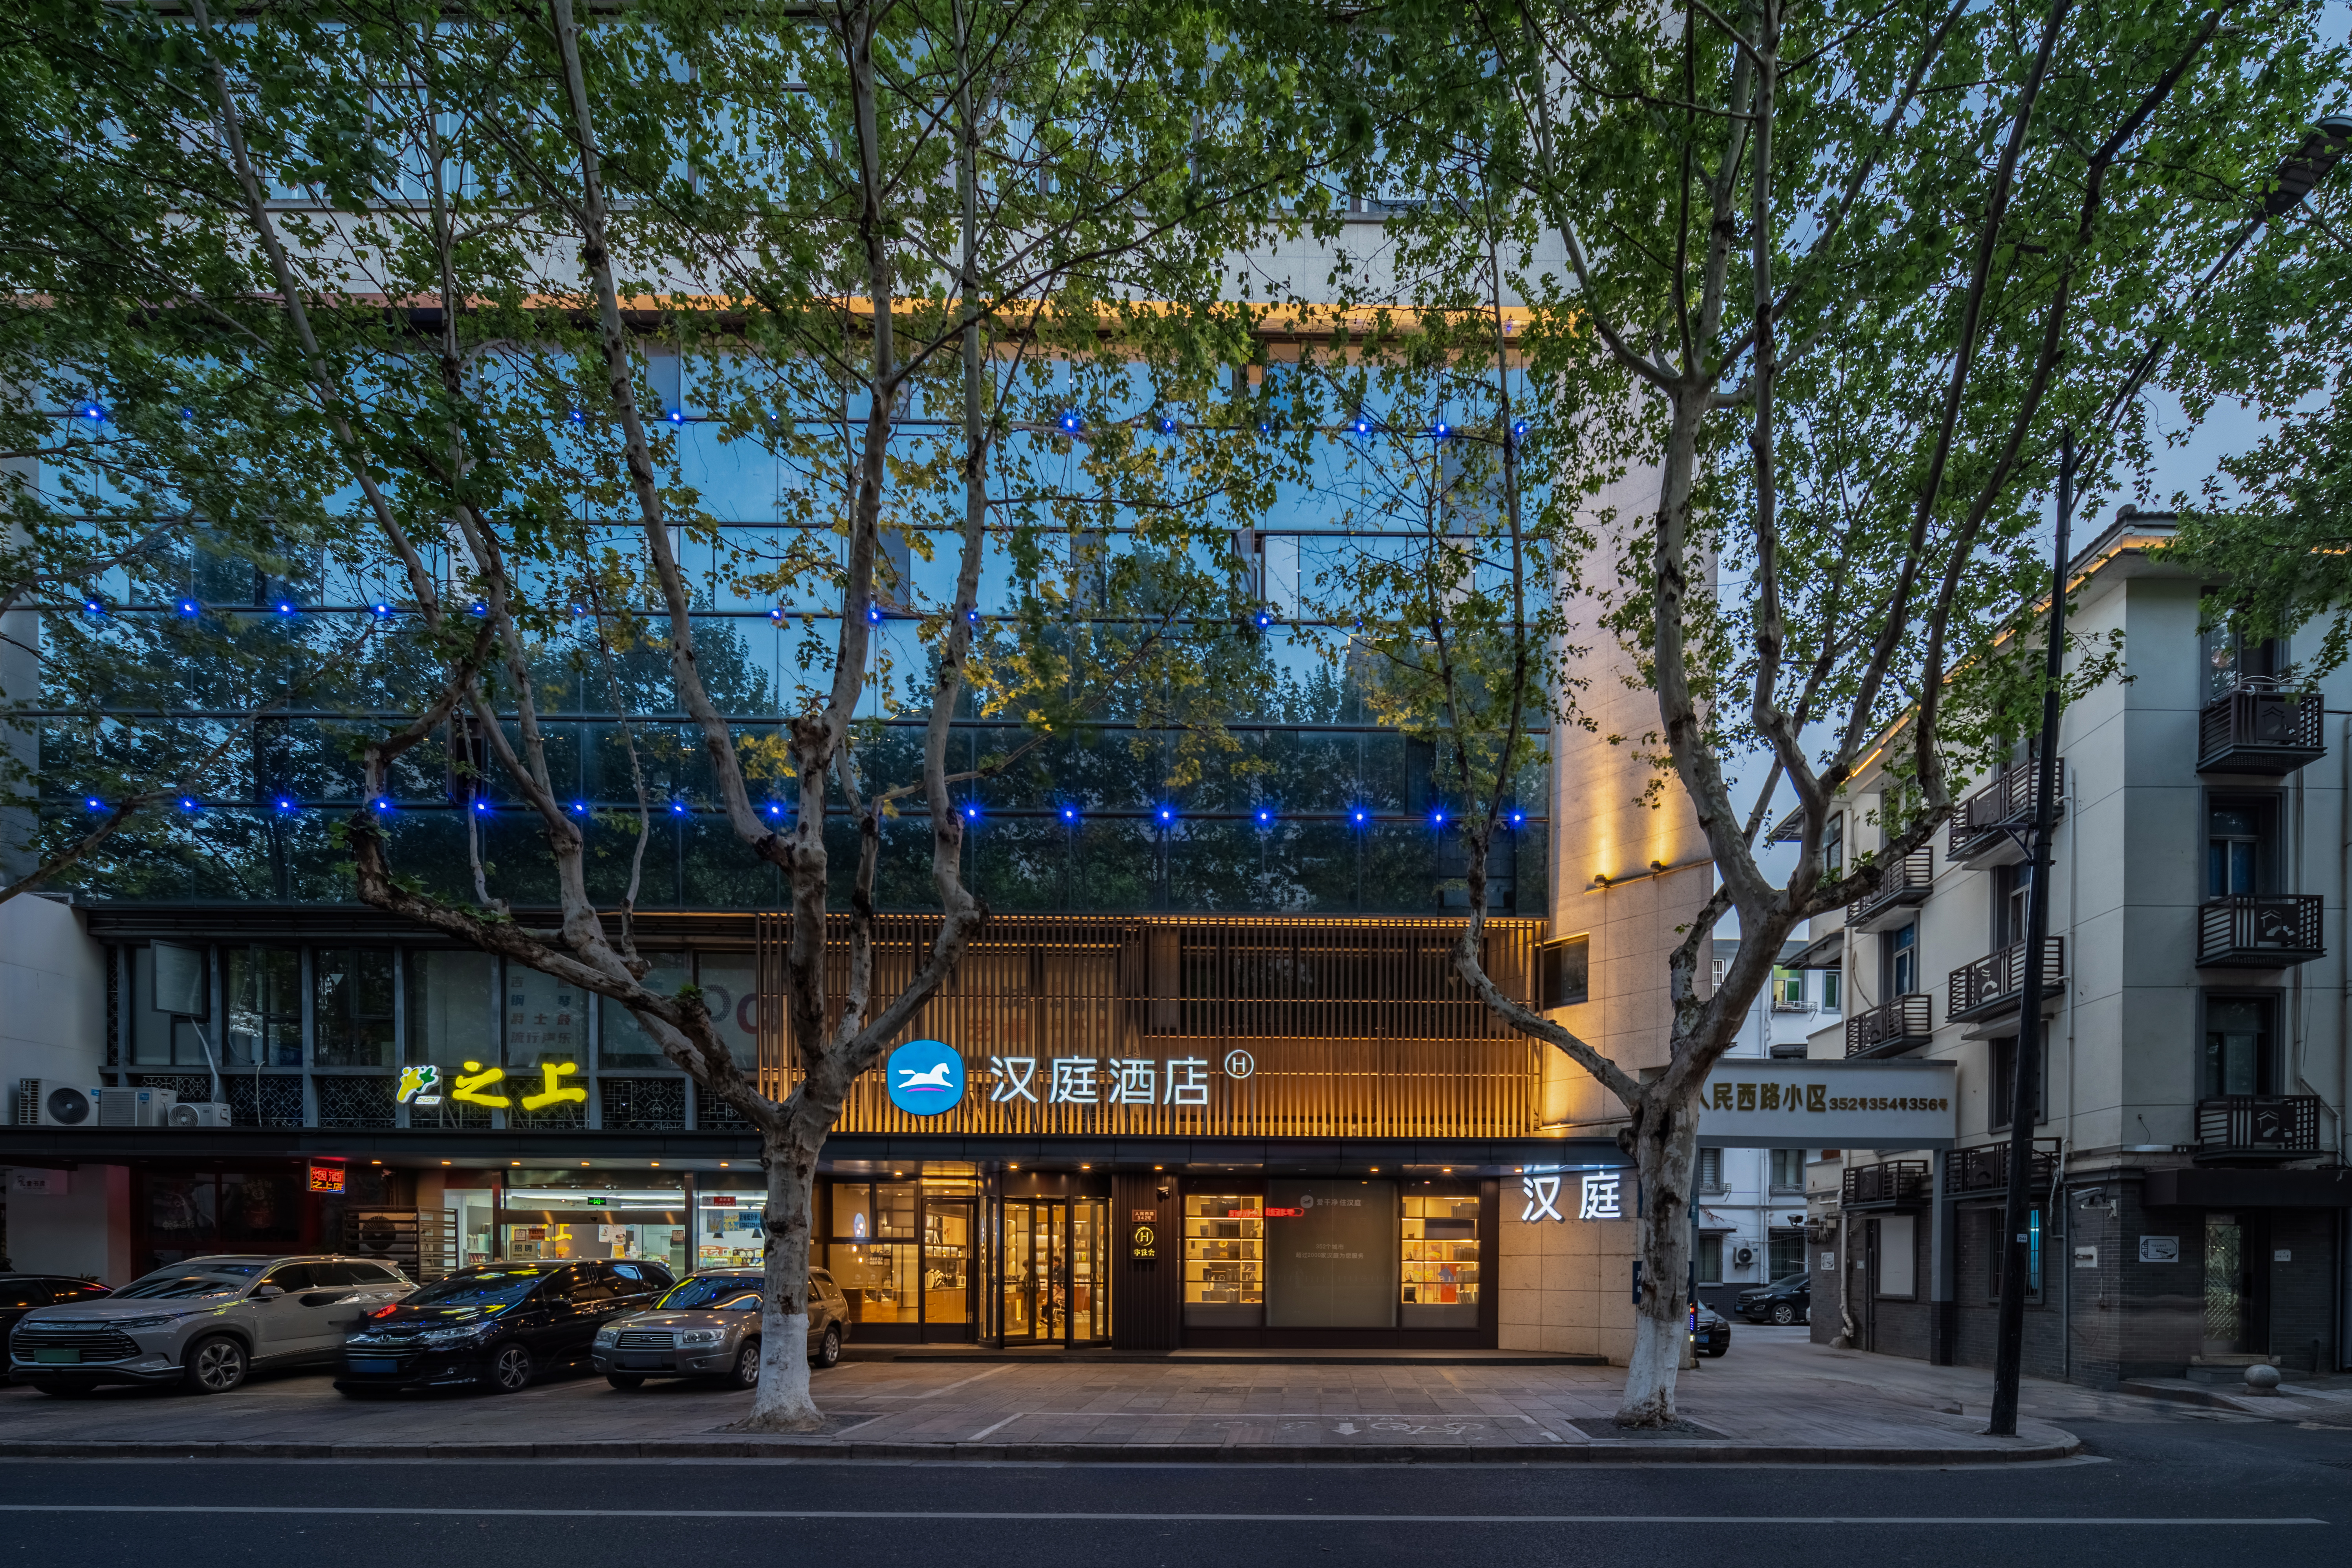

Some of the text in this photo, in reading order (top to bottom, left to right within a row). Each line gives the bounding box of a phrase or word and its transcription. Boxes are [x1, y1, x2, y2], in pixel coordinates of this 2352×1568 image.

[511, 995, 572, 1007] 钢琴
[511, 1013, 572, 1026] 爵士鼓
[511, 1032, 572, 1044] 流行声乐
[452, 1061, 588, 1111] 之上
[989, 1054, 1209, 1106] 汉庭酒店
[1829, 1097, 1949, 1111] 352号354号356号
[313, 1169, 343, 1183] 烟酒
[312, 1180, 343, 1191] 之上店
[1521, 1172, 1622, 1221] 汉庭
[514, 1244, 533, 1252] 招聘
[1134, 1248, 1155, 1257] 华住会
